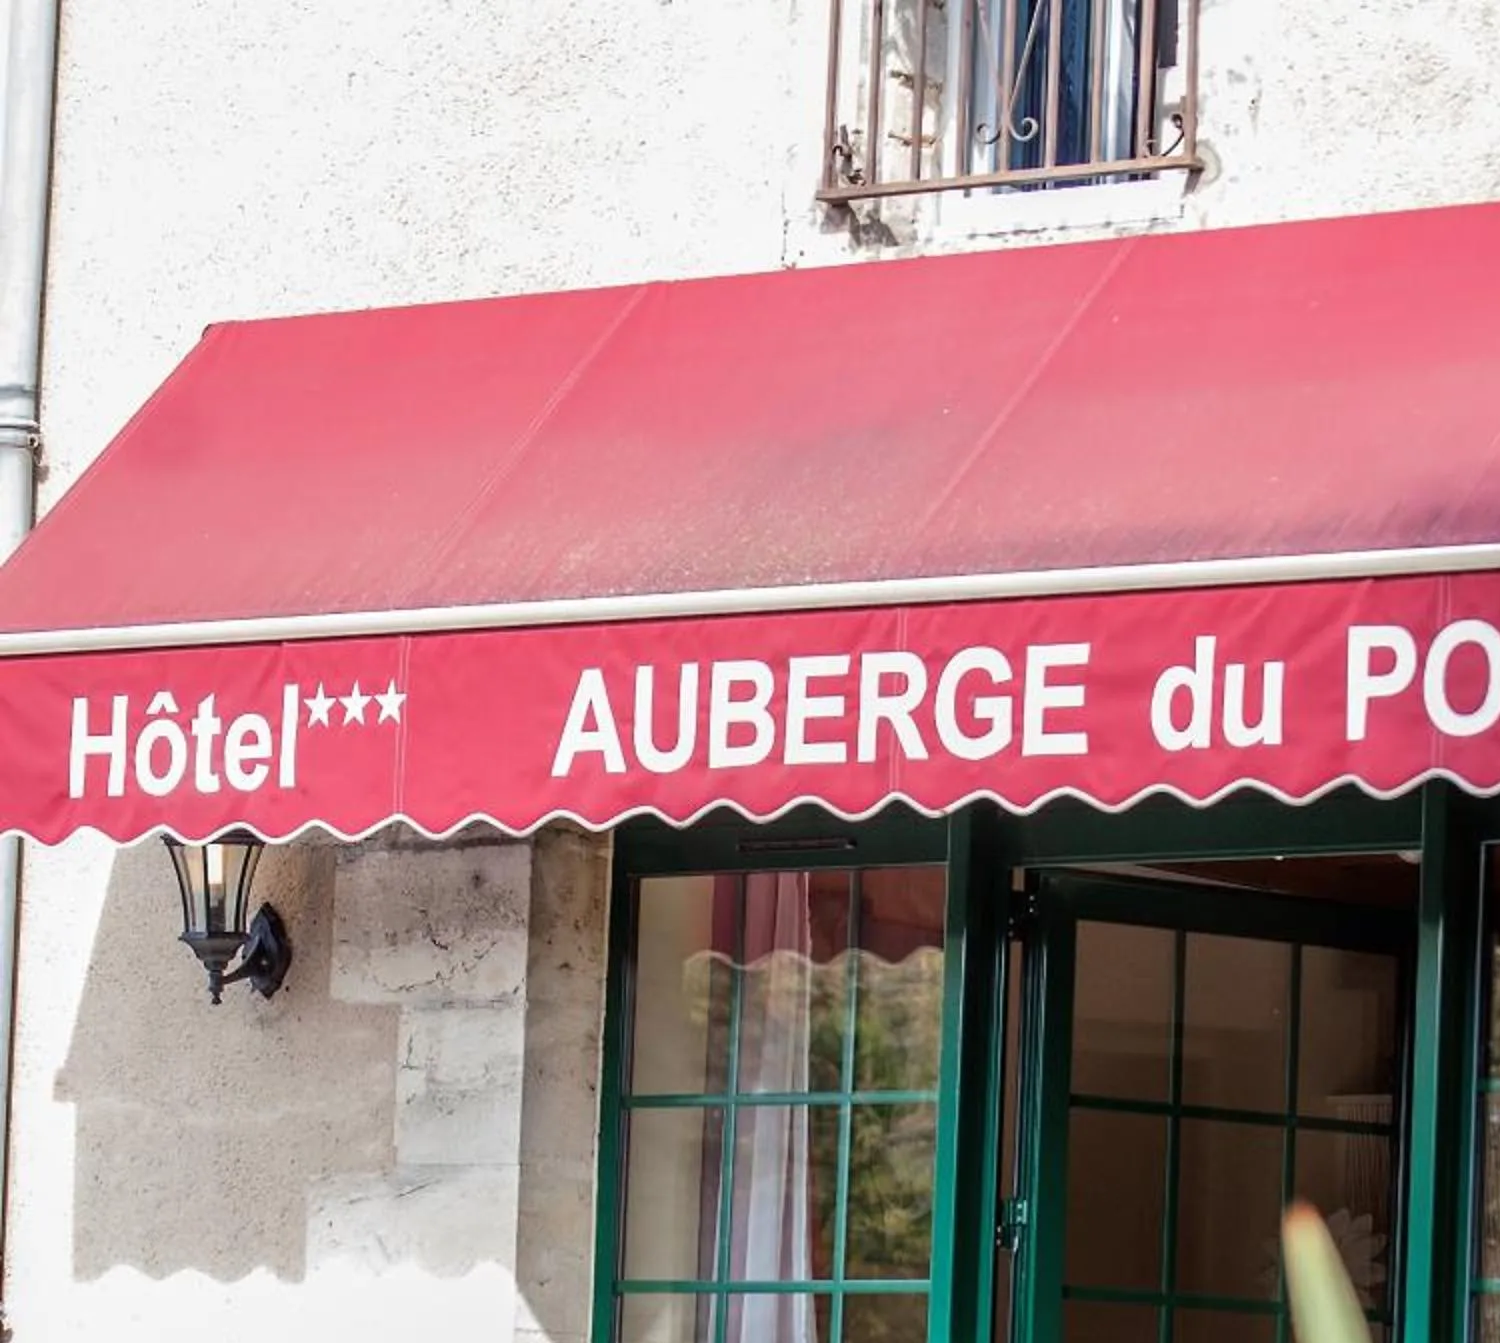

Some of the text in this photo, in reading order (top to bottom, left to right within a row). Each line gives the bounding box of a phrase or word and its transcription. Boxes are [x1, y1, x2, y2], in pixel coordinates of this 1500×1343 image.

[70, 684, 298, 798] Hôtel
[552, 643, 1090, 776] AUBERGE
[1151, 636, 1283, 751] du
